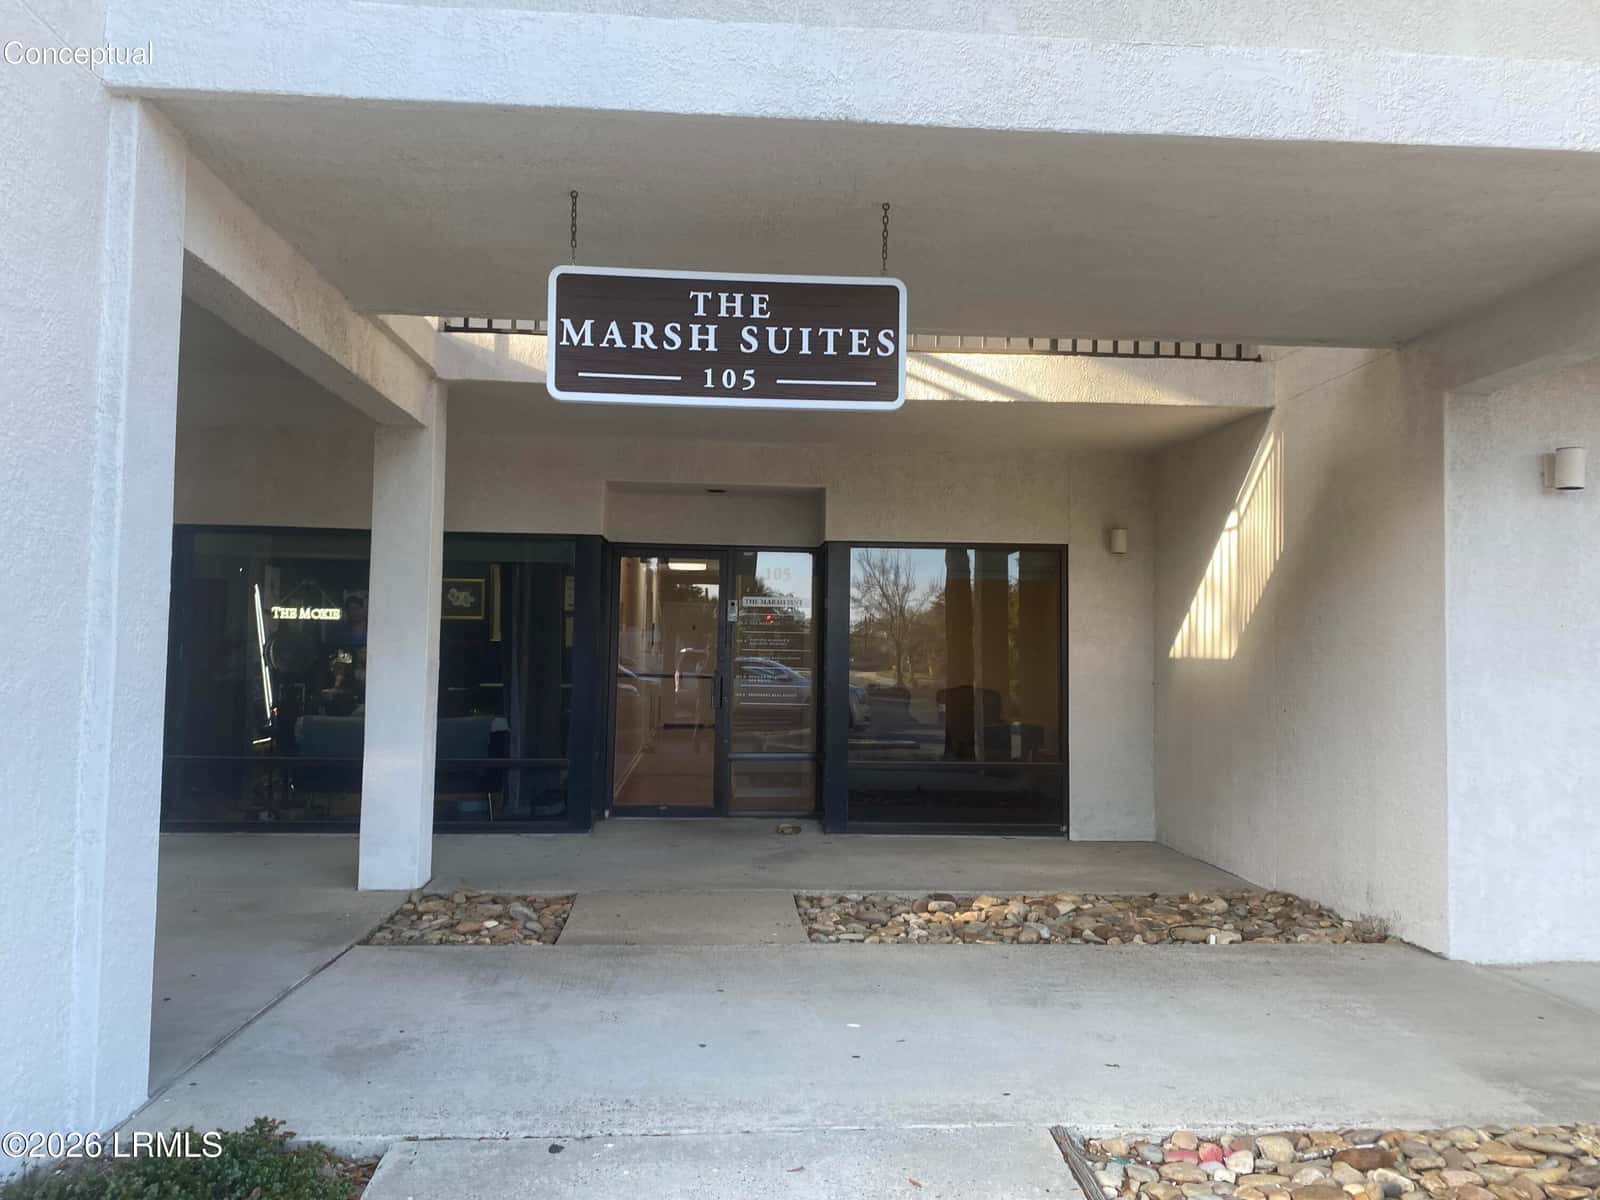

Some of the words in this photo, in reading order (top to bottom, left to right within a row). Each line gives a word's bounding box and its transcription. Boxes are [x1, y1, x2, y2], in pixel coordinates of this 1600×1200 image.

[689, 291, 771, 319] THE
[559, 318, 719, 353] MARSH
[739, 326, 896, 357] SUITES
[703, 367, 757, 391] 105
[766, 568, 792, 581] 105
[271, 605, 298, 620] THE
